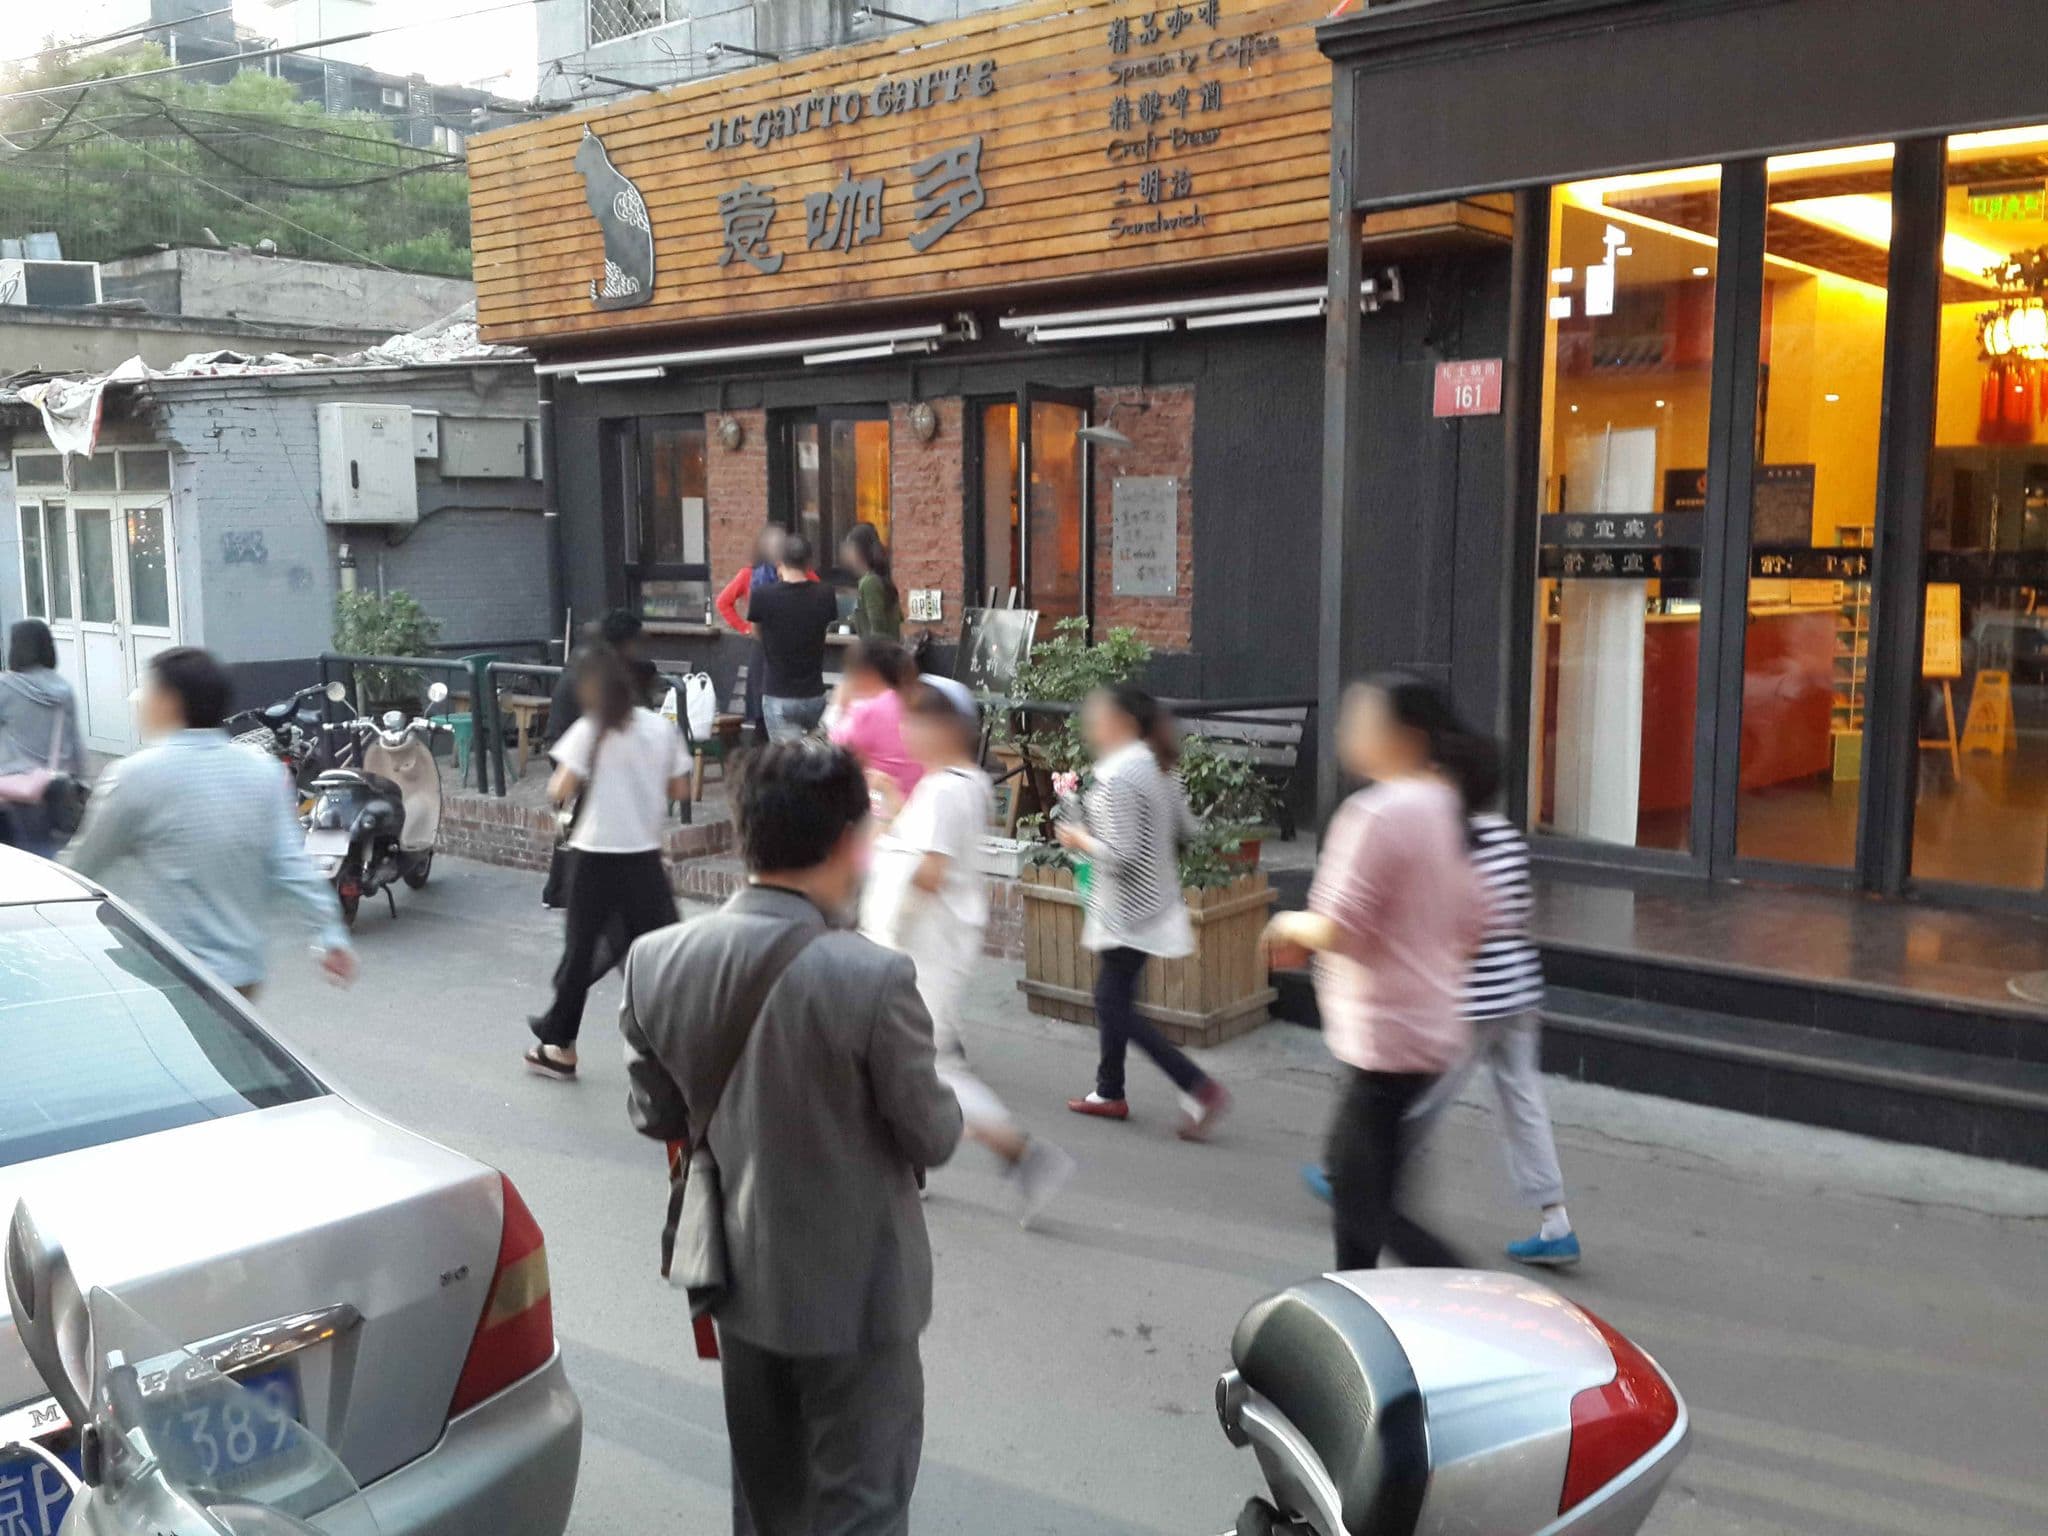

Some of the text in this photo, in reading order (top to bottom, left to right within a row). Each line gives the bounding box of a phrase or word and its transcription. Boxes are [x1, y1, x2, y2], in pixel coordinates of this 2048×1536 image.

[1208, 31, 1280, 70] Coffee
[1106, 127, 1221, 161] Craft Beer
[1112, 166, 1192, 205] 三明治
[717, 136, 986, 275] 意咖多
[1109, 204, 1206, 239] Sandwich
[1455, 384, 1481, 409] 161
